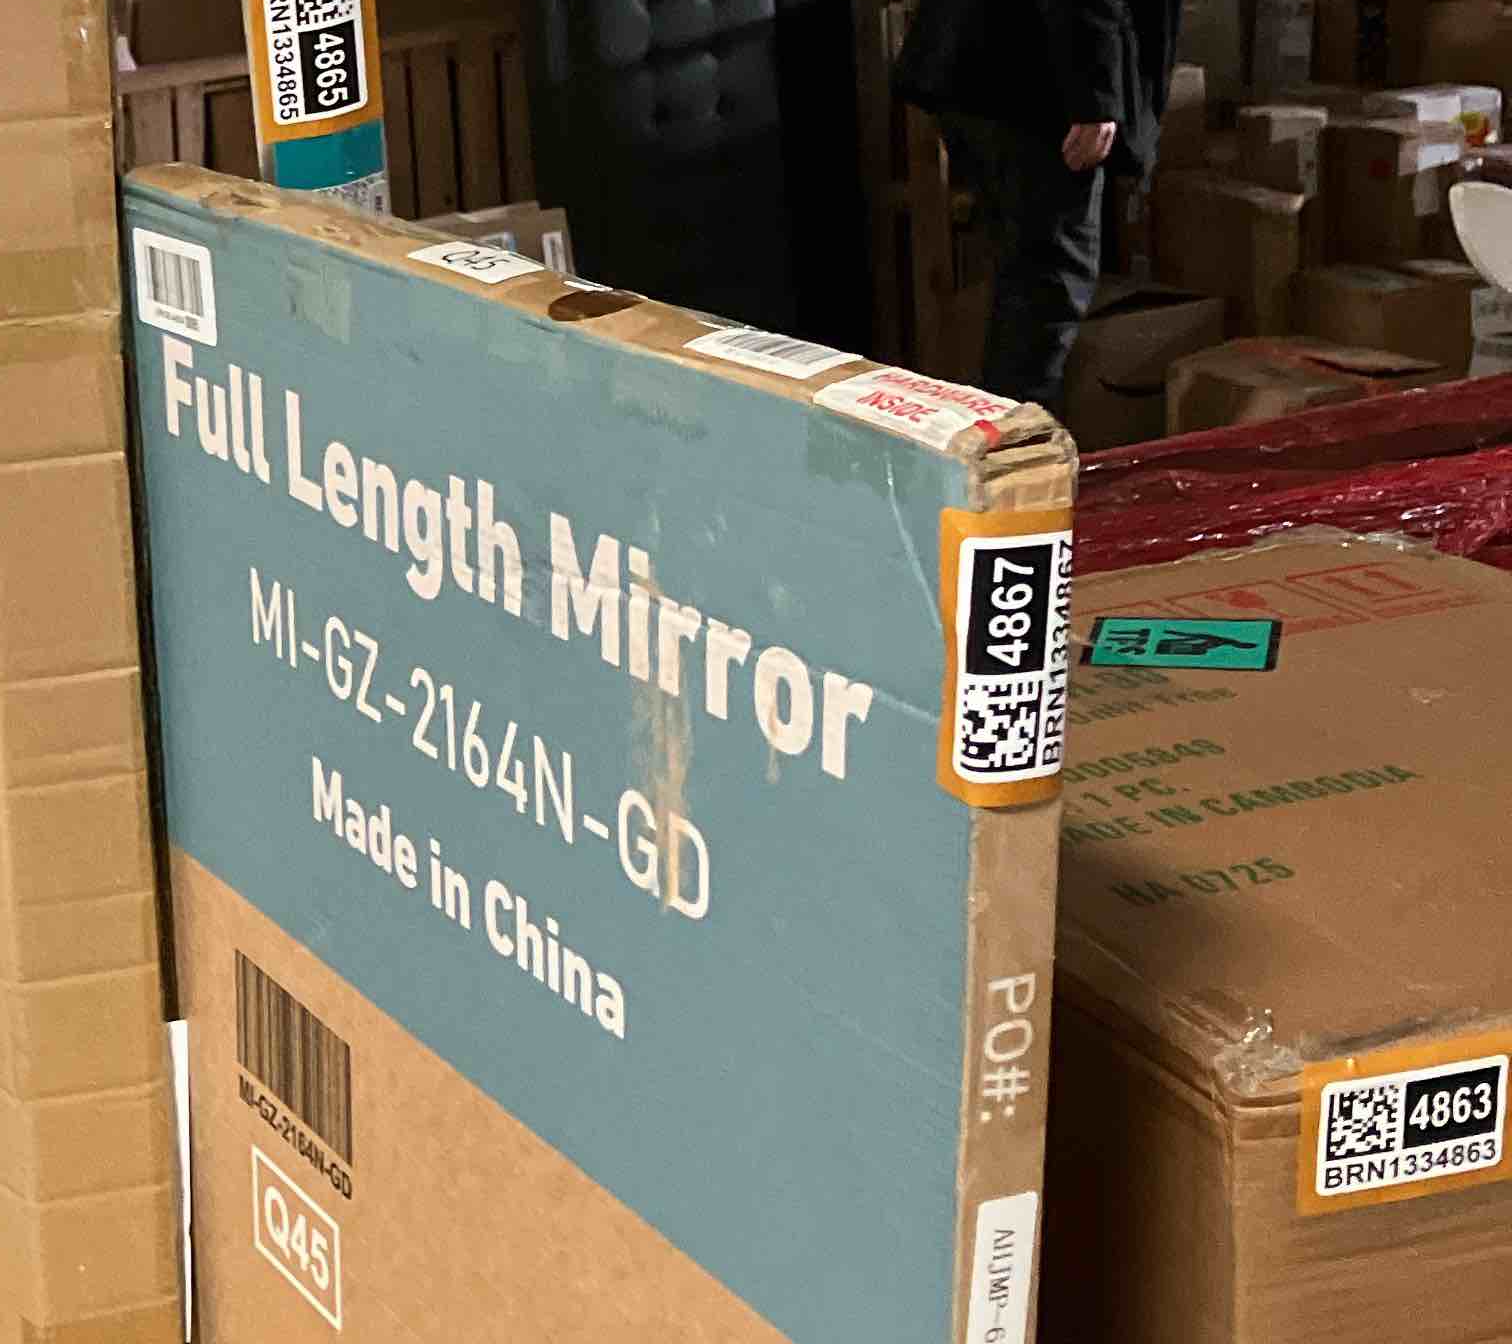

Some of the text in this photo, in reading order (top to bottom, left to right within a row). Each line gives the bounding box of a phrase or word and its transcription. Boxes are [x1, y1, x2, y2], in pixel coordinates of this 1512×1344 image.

[313, 31, 349, 109] 4865
[857, 390, 940, 424] INSIDE
[872, 368, 1009, 417] HARDWARE
[163, 335, 874, 780] Full Length Mirror
[986, 556, 1036, 668] 4867
[249, 566, 711, 920] MI-GZ-2164N-GD
[1199, 764, 1424, 818] CAMBODIA
[311, 756, 626, 1040] Made in China
[979, 972, 1037, 1124] PO#:
[1408, 1082, 1492, 1131] 4863
[1324, 1139, 1497, 1189] BRN1334863
[263, 1185, 331, 1291] Q45
